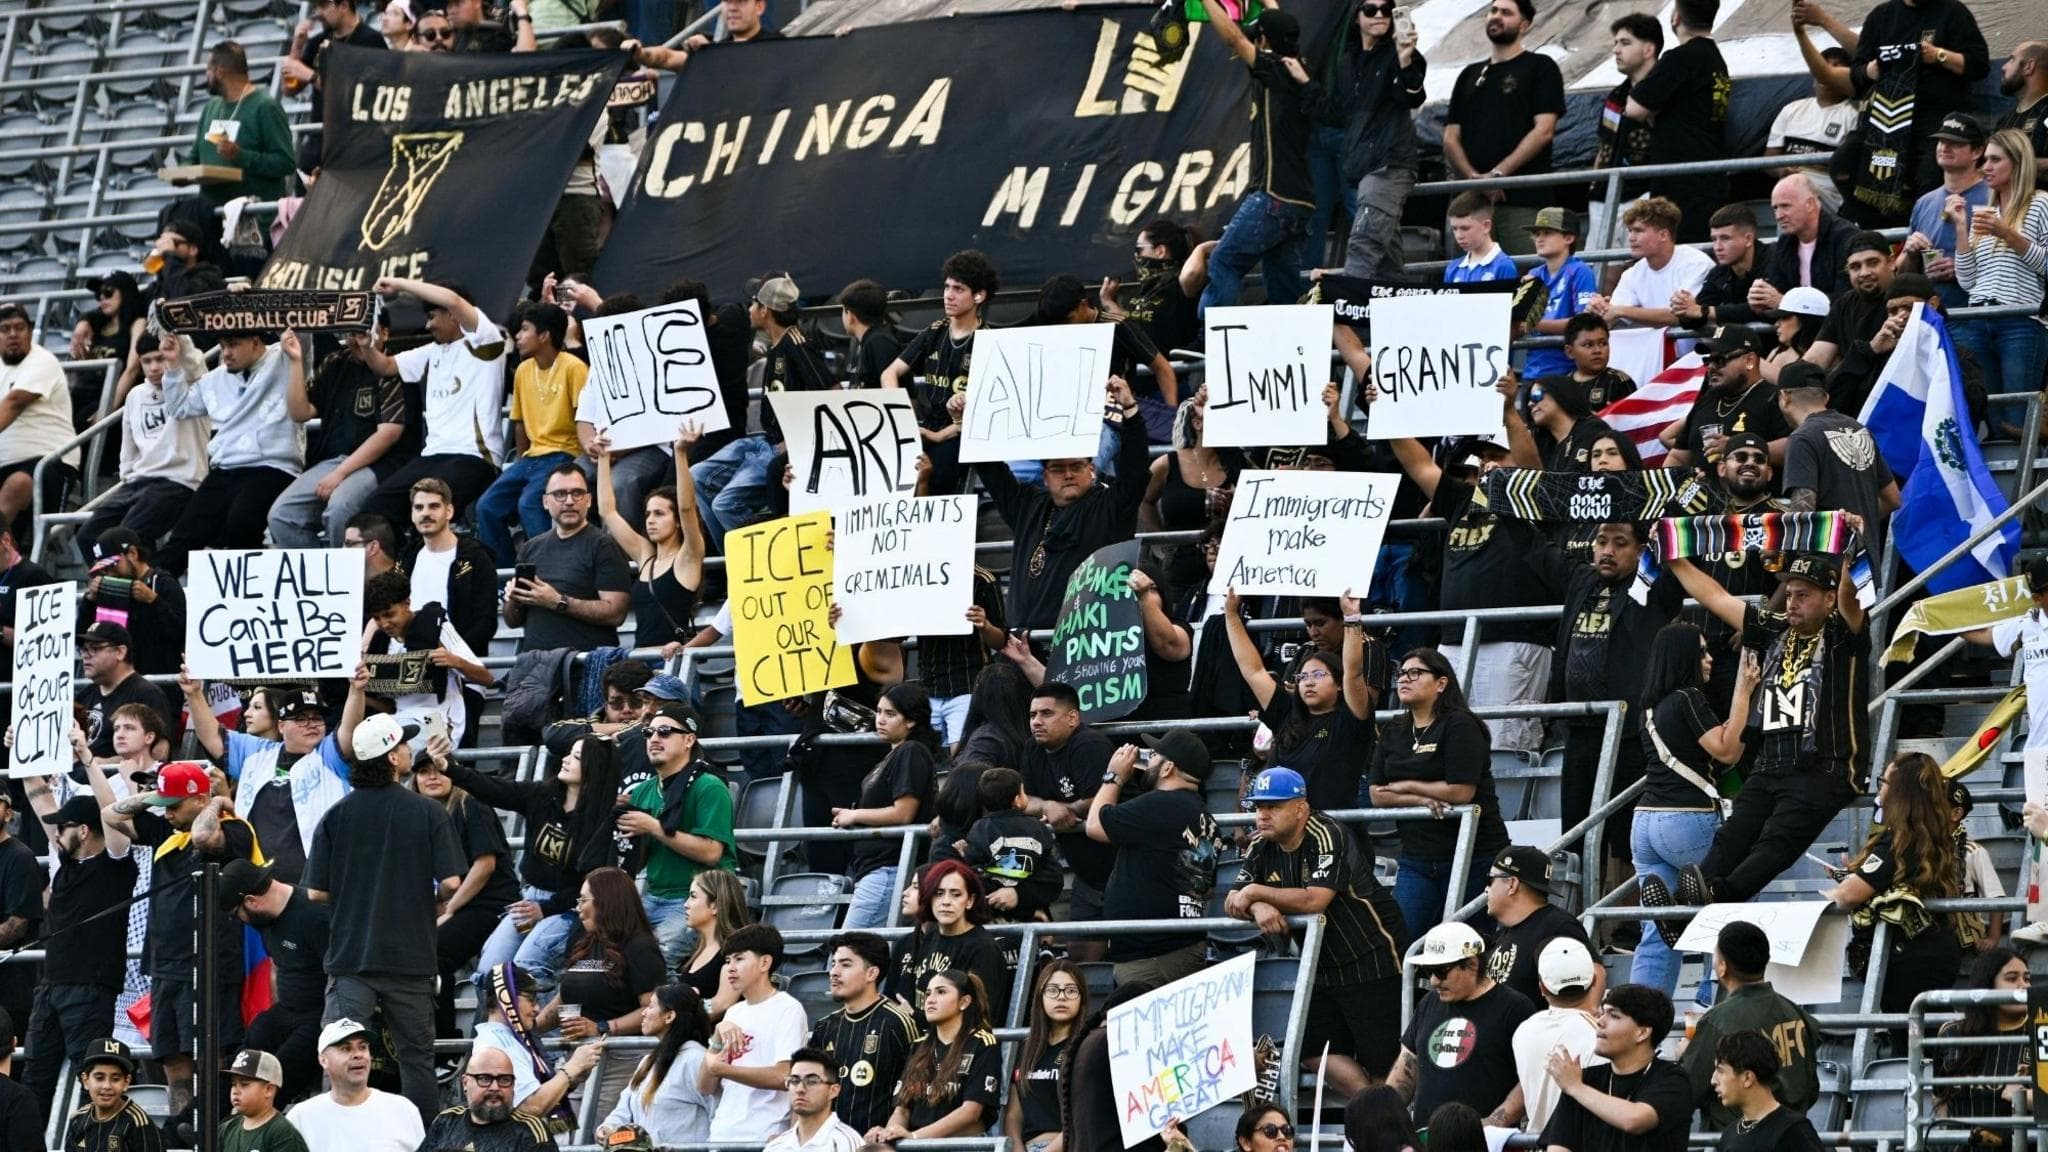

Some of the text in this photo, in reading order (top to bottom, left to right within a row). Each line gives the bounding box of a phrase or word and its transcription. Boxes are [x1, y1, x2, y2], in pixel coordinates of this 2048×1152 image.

[352, 72, 602, 122] LOS ANGELES
[645, 77, 952, 199] CHINGA
[982, 142, 1250, 227] MIGRA
[204, 310, 328, 331] FOOTBALL CLUB
[588, 310, 716, 425] WE
[968, 340, 1100, 440] ALL
[1375, 342, 1503, 402] GRANTS
[806, 400, 916, 497] ARE
[845, 496, 963, 537] IMMIGRANTS
[1232, 477, 1385, 522] Immigrants
[742, 521, 823, 583] ICE
[872, 528, 912, 555] NOT
[1267, 524, 1327, 555] make
[208, 551, 350, 600] WE ALL
[844, 561, 951, 595] CRIMINALS
[1227, 555, 1318, 588] America
[25, 586, 64, 633] ICE
[199, 599, 346, 647] Can't Be
[742, 582, 833, 620] OUT OF
[229, 637, 343, 677] HERE
[776, 619, 820, 649] OUR
[1066, 625, 1142, 666] PANTS
[38, 671, 70, 705] OUR
[752, 640, 837, 697] CITY
[1078, 672, 1143, 712] CISM
[15, 706, 64, 765] CITY
[1146, 1023, 1209, 1077] MAKE
[1126, 1037, 1237, 1123] AMERICA
[1149, 1078, 1223, 1130] GREAT
